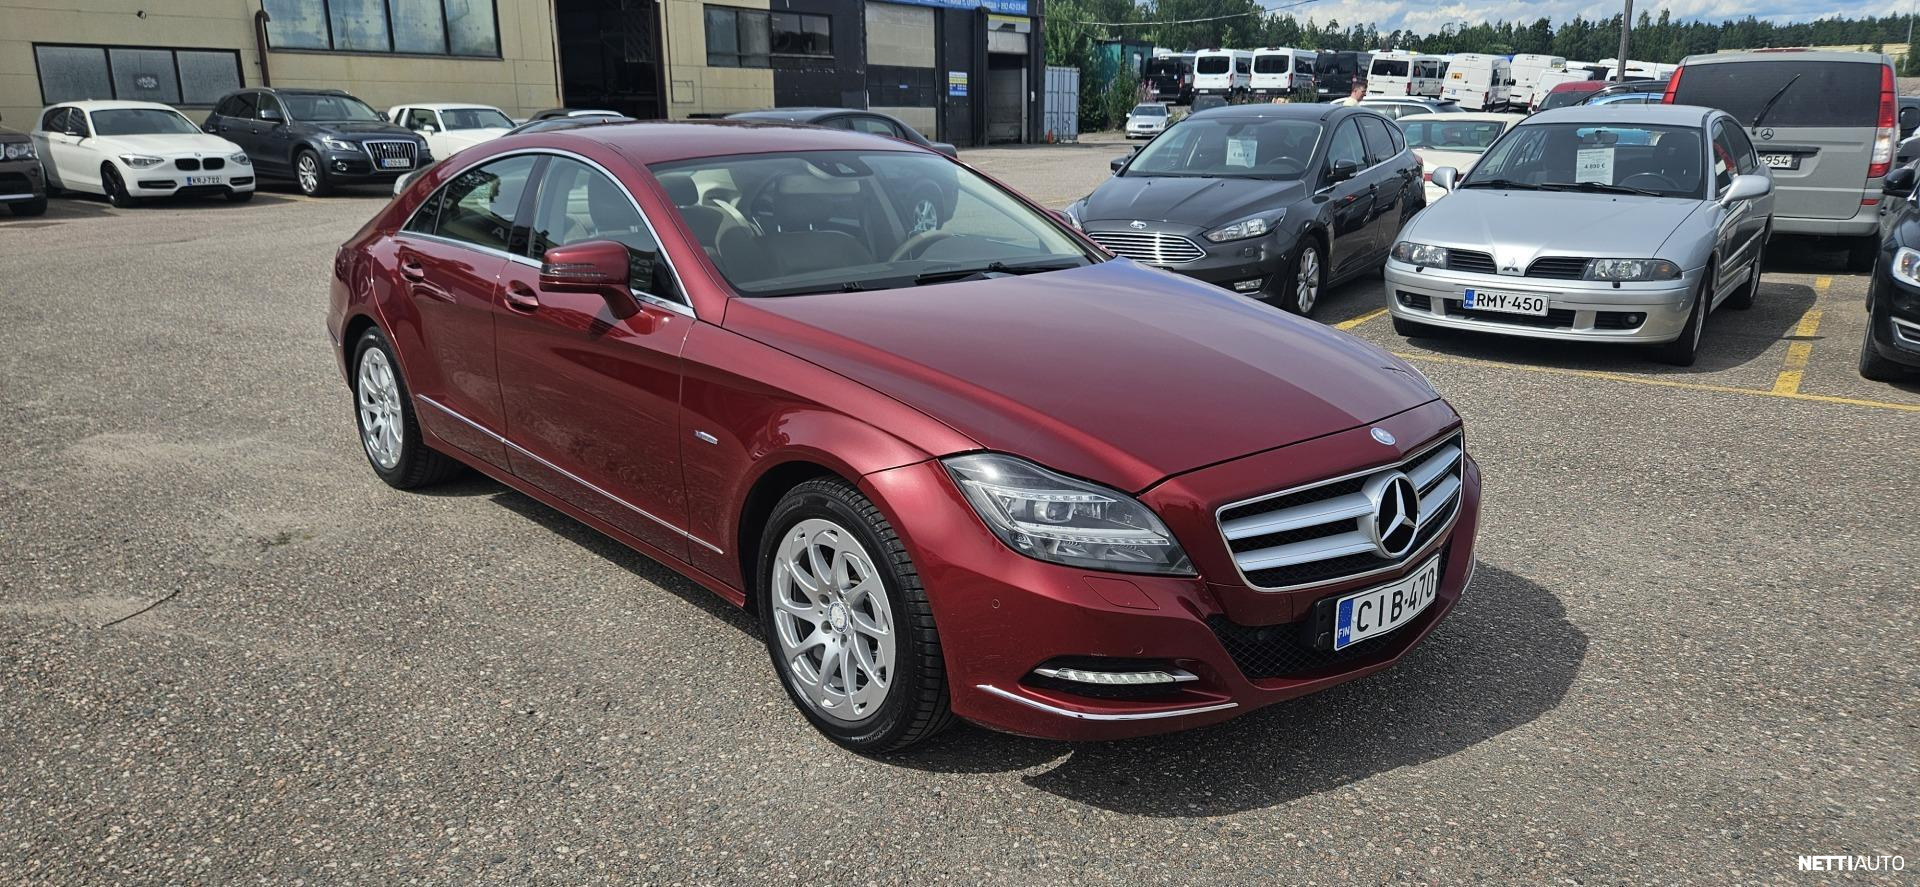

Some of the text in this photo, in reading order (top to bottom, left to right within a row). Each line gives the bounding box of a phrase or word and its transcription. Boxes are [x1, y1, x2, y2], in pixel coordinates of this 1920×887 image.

[1476, 293, 1544, 312] RMY-450
[1337, 567, 1435, 639] FIN CIB-470
